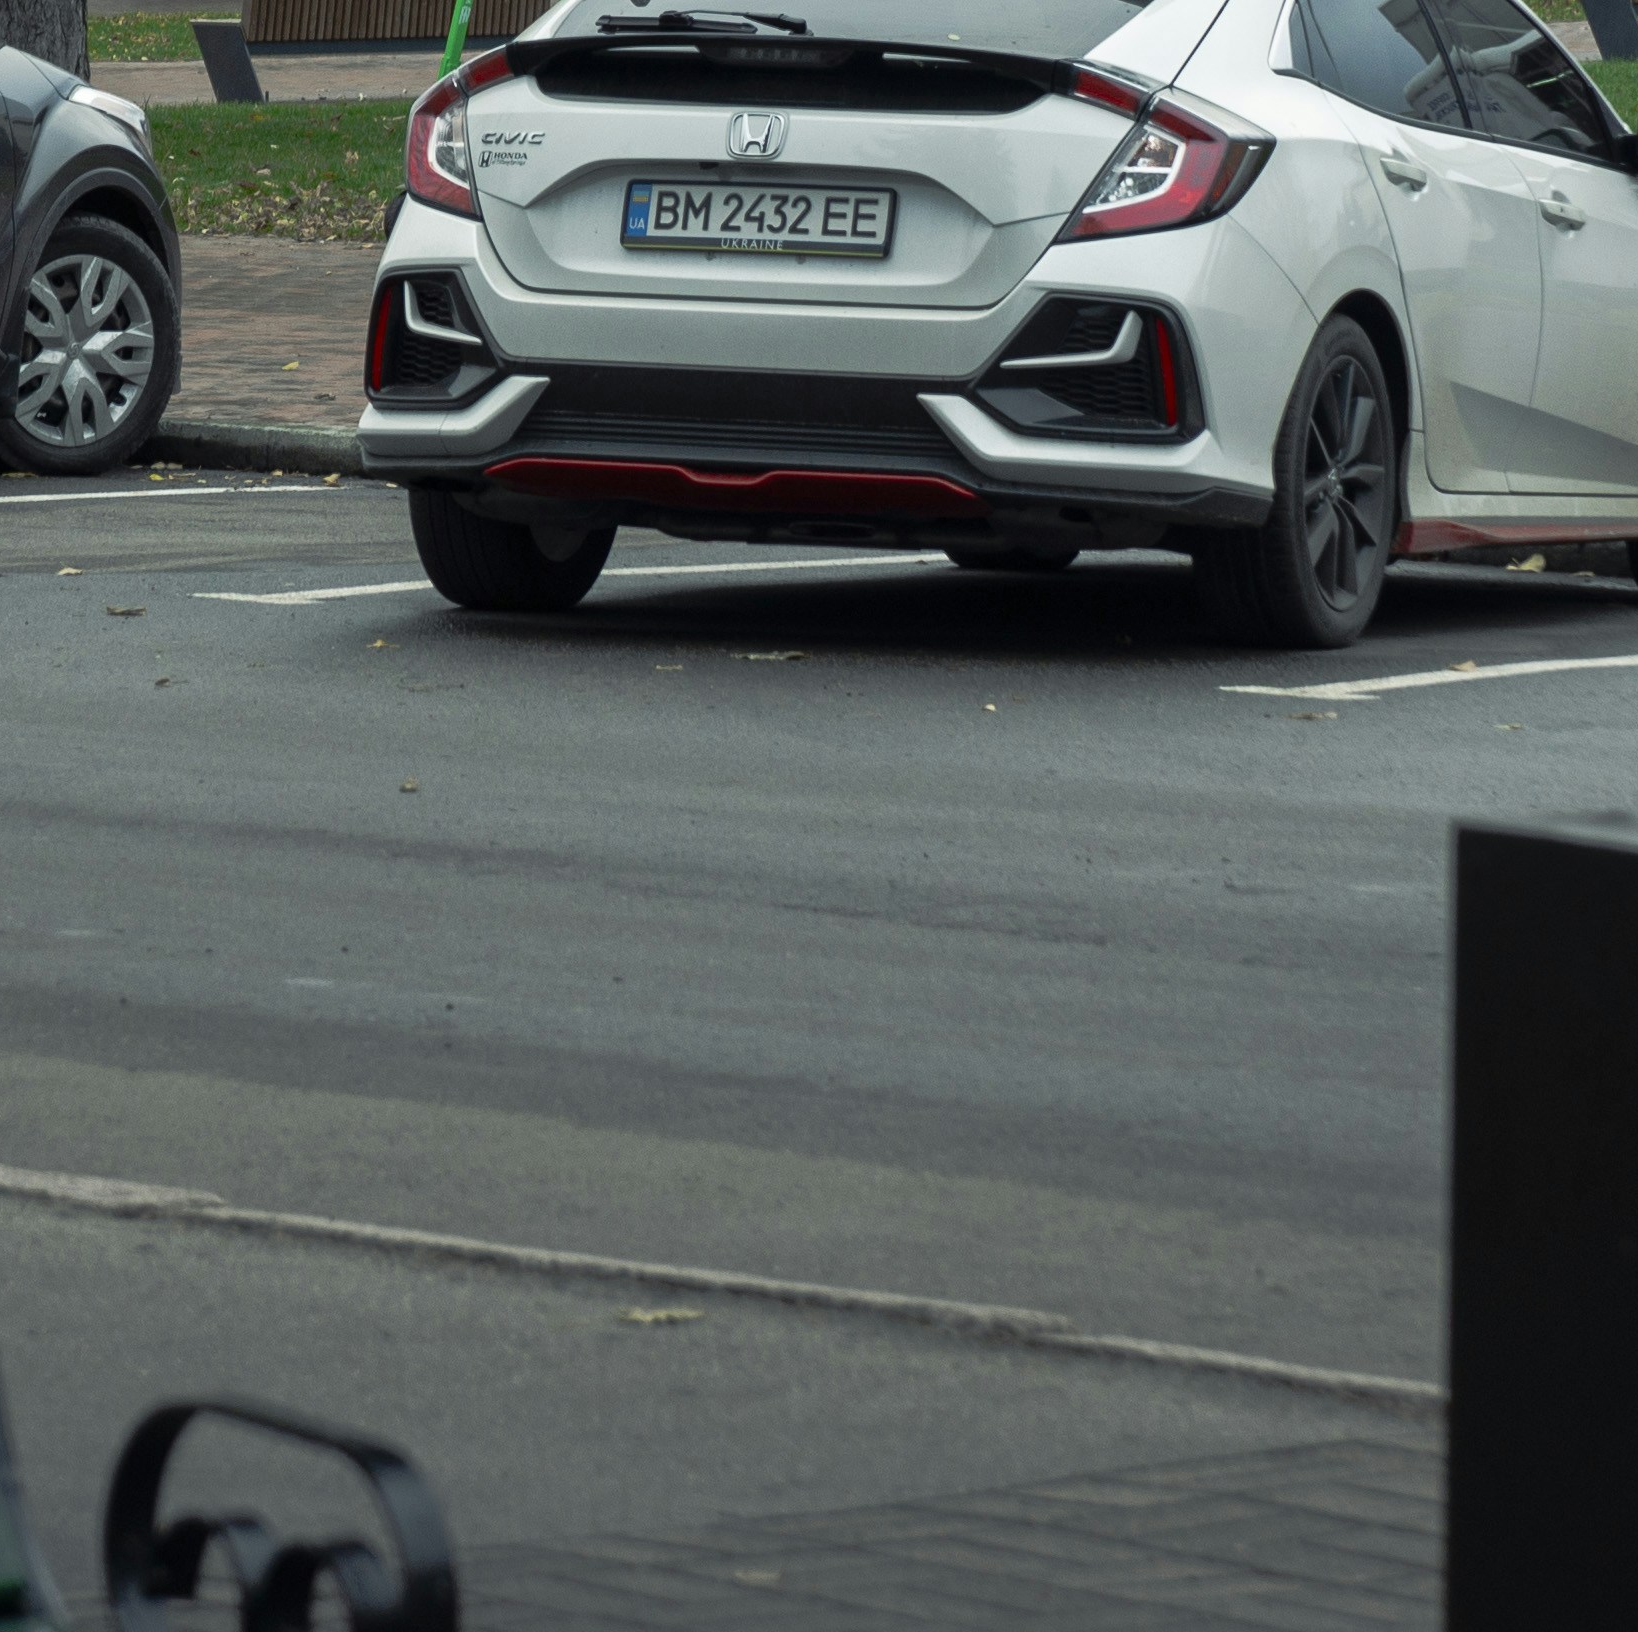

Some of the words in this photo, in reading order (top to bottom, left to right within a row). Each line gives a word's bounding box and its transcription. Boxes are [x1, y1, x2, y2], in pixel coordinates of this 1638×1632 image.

[481, 131, 546, 145] CIVIC
[493, 151, 529, 161] HONDA
[653, 190, 712, 232] BM
[719, 192, 813, 235] 2432
[820, 196, 879, 239] EE
[628, 216, 645, 231] UA
[720, 237, 784, 252] UKRAINE
